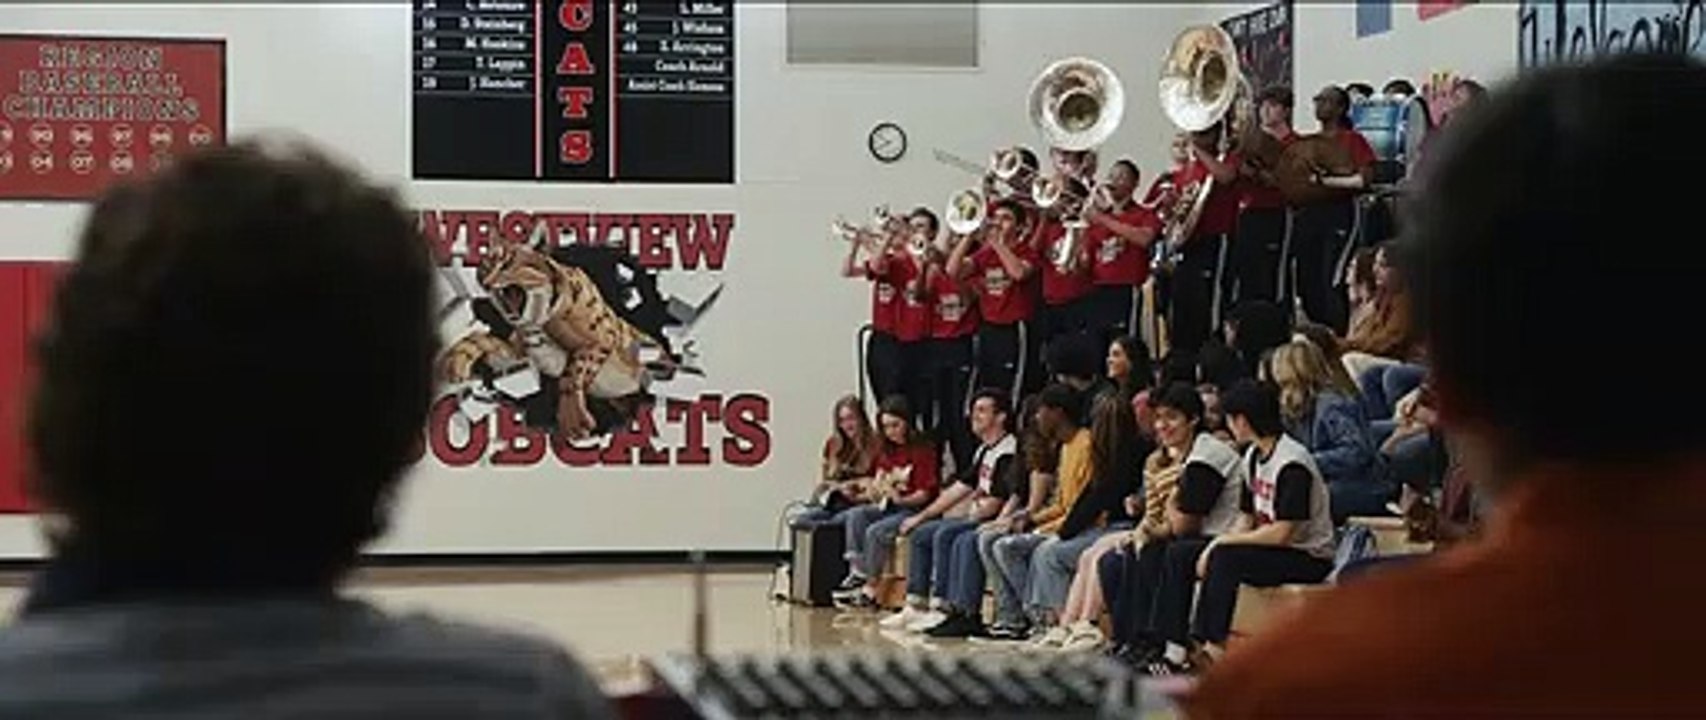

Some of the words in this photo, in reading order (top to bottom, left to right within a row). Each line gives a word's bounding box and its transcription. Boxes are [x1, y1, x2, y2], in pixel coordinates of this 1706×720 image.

[39, 43, 162, 69] REGION
[655, 59, 687, 71] Coach
[19, 70, 183, 98] BASEBALL
[3, 94, 200, 123] CHAMPIONS
[424, 393, 771, 468] OBATS
